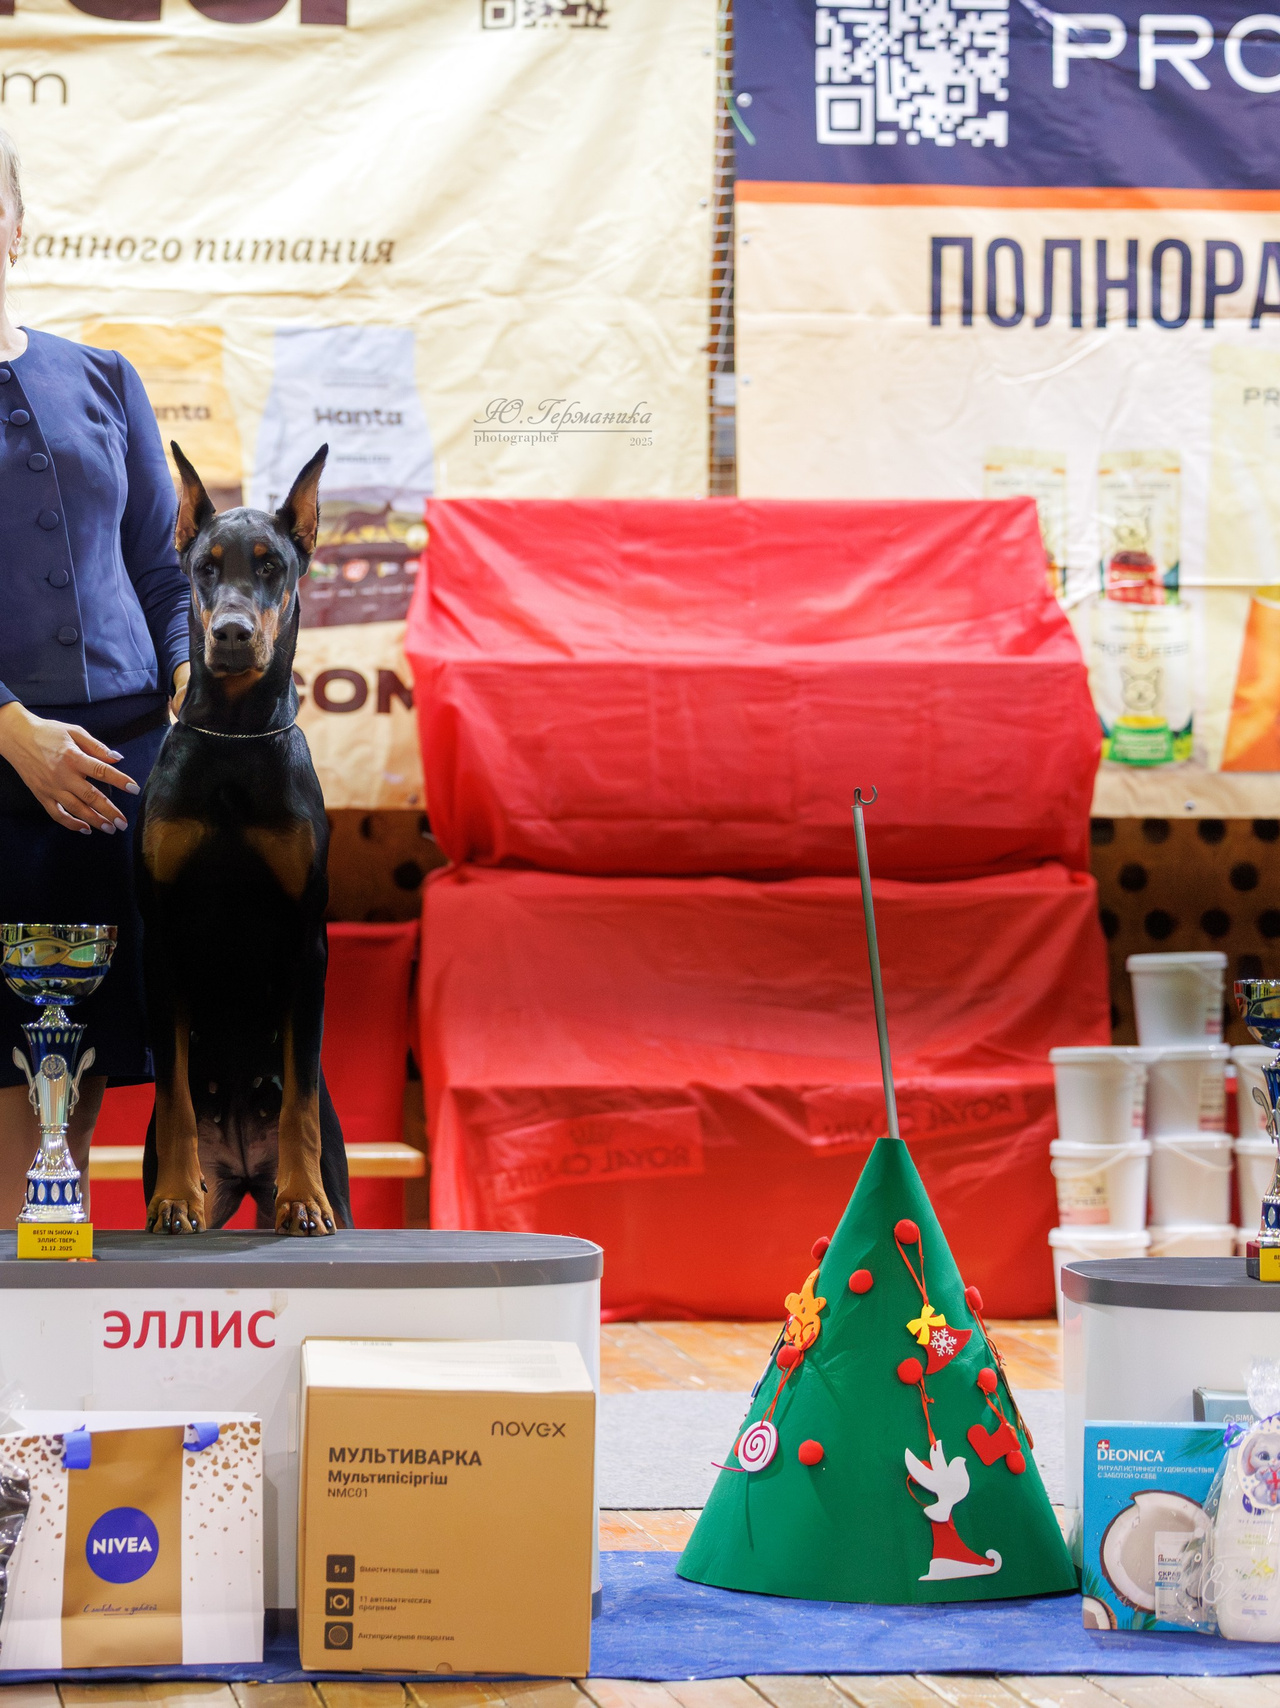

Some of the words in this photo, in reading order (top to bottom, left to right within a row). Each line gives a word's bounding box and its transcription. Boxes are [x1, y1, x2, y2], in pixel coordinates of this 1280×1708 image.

[192, 237, 396, 265] питания
[314, 406, 403, 426] Hanta
[103, 1310, 276, 1349] ЭЛЛИС
[328, 1447, 482, 1466] МУЛЬТИВАРКА
[1097, 1449, 1164, 1462] DEONICA
[327, 1469, 448, 1488] Мультипісіргіш
[327, 1488, 368, 1498] NMC01
[92, 1536, 152, 1555] NIVEA
[360, 1566, 418, 1574] Вместительная
